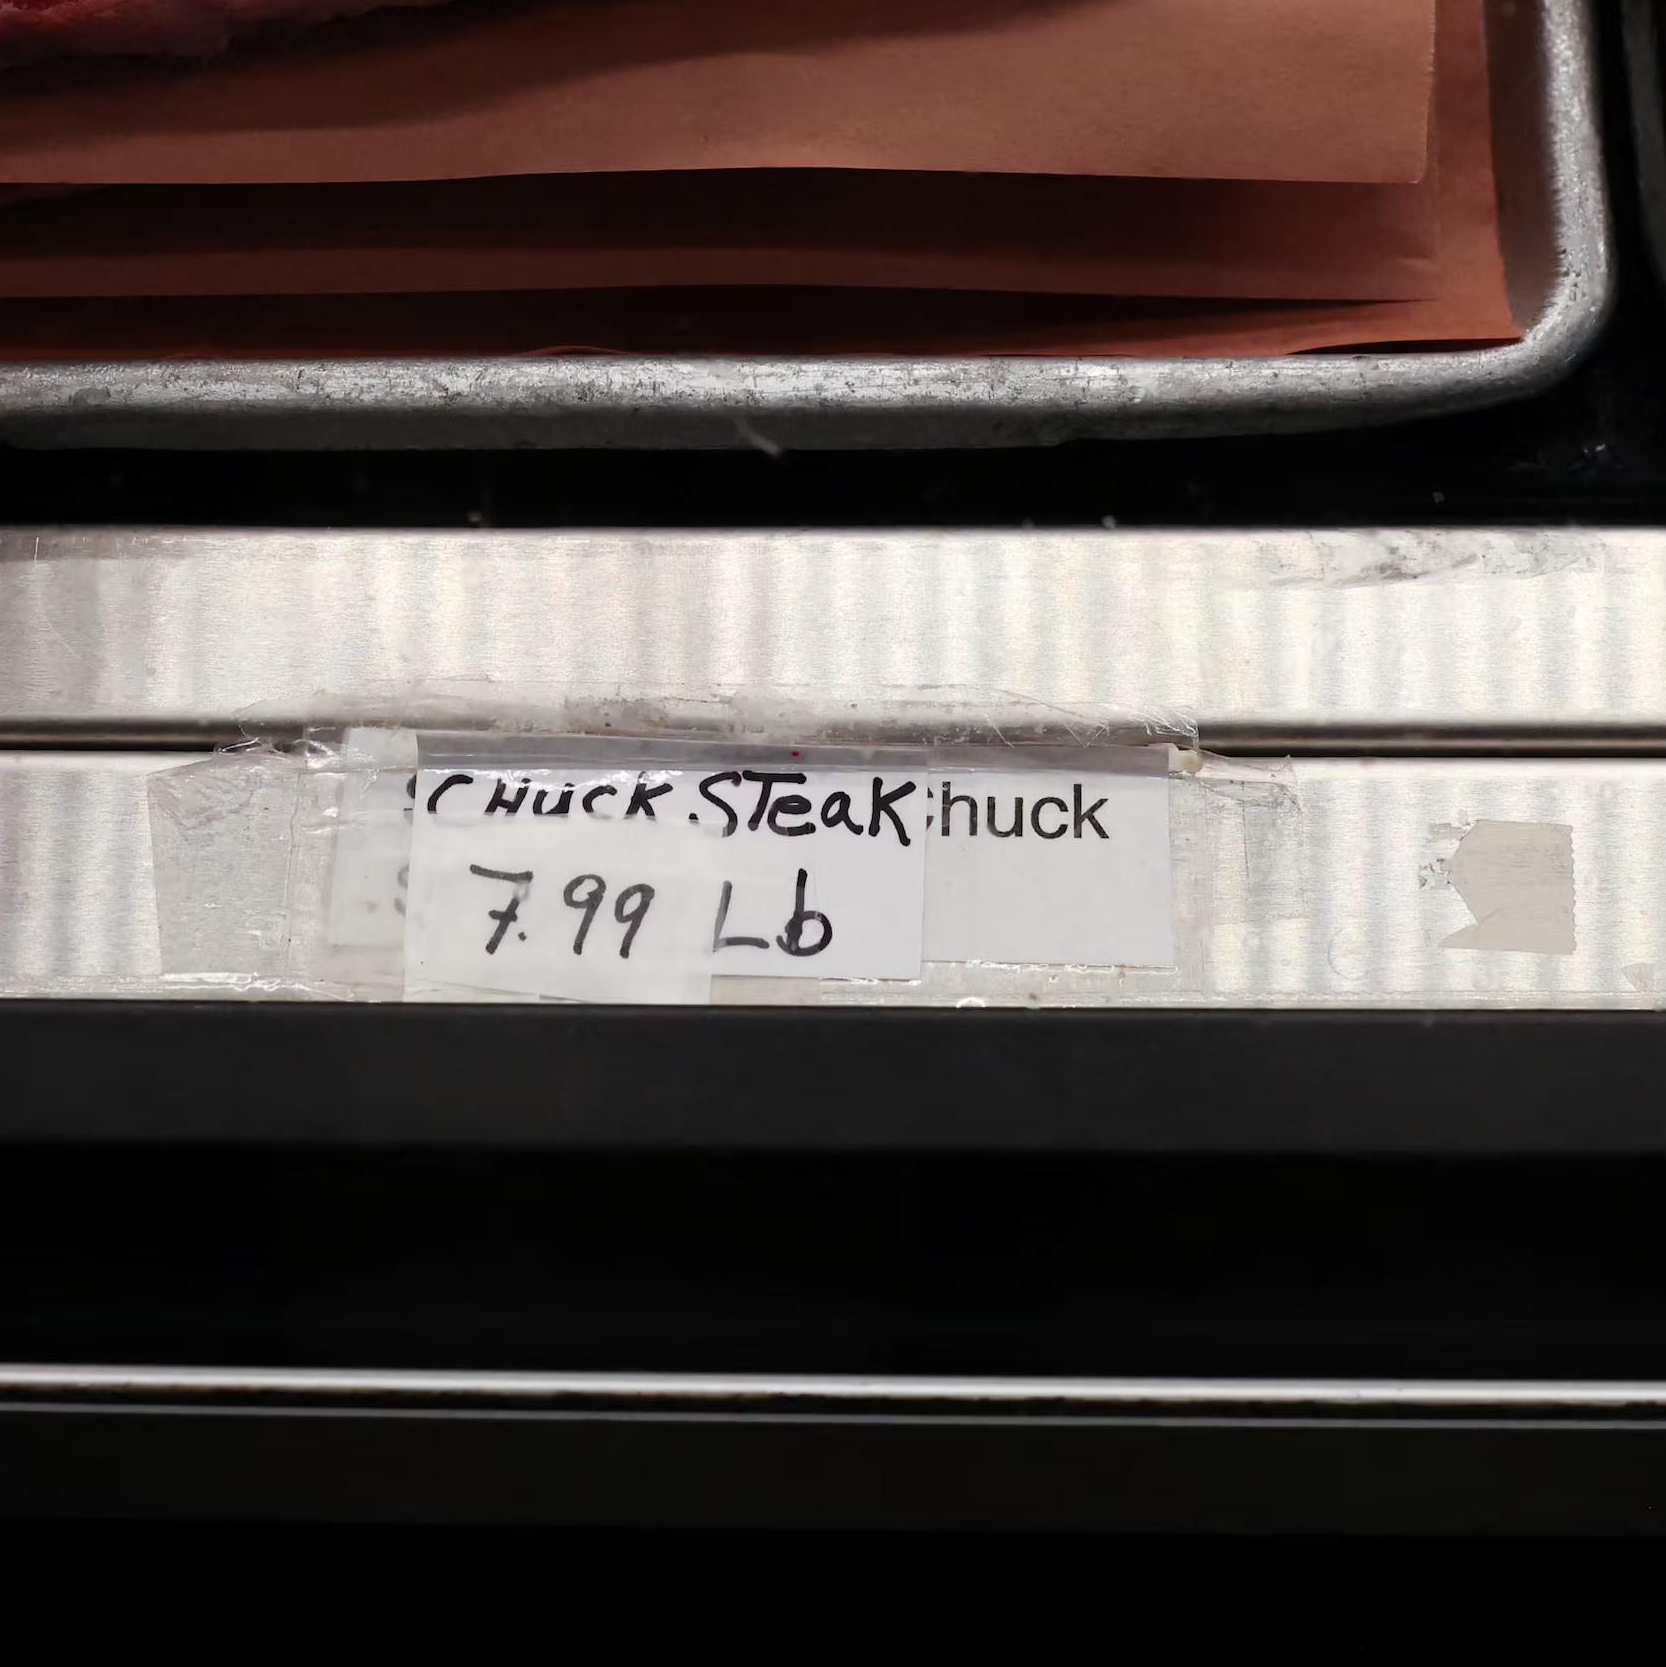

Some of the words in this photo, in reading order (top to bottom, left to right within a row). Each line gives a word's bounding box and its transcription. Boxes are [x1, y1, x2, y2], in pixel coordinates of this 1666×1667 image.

[926, 781, 1110, 840] huck
[469, 863, 655, 959] 7.99
[711, 868, 833, 957] Lb
